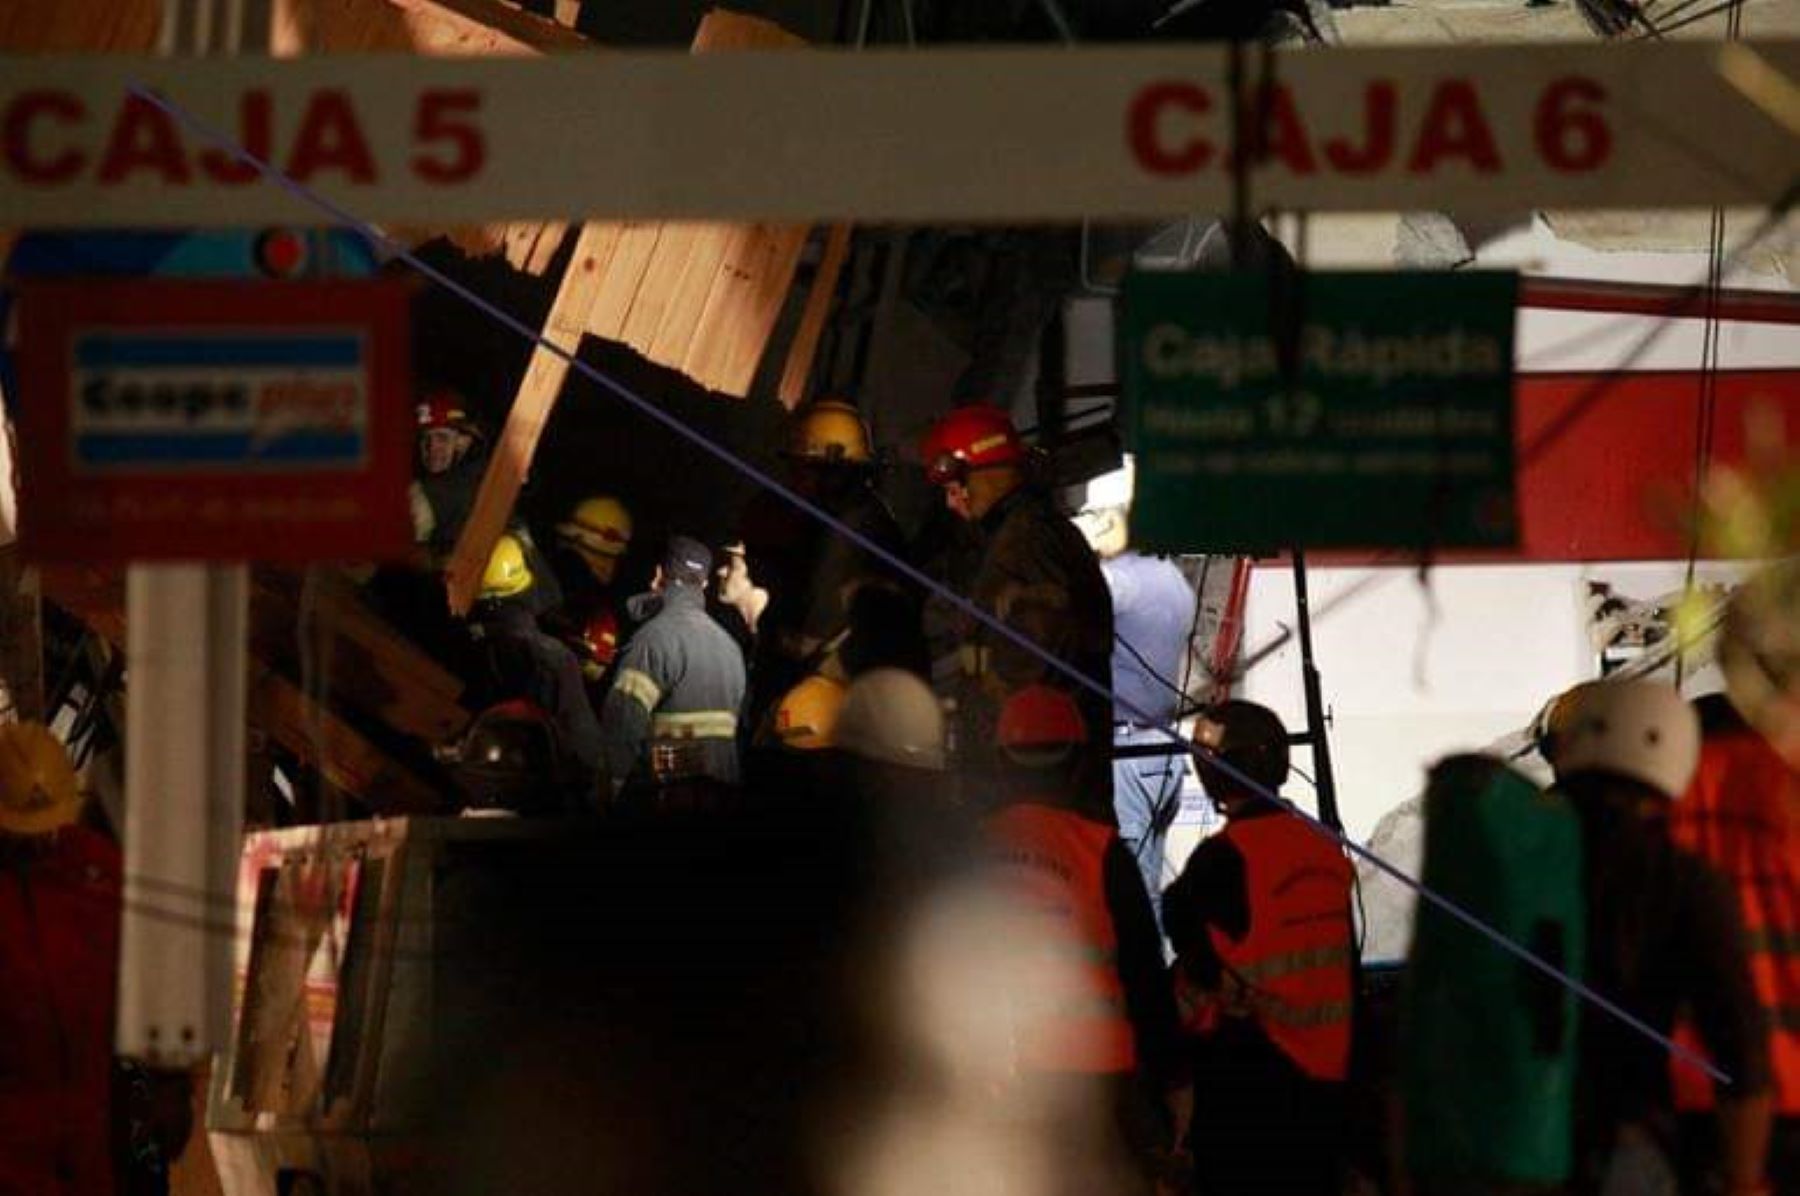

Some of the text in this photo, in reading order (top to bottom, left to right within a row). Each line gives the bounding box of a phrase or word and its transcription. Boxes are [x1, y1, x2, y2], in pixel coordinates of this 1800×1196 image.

[3, 86, 486, 186] CAJA 5
[1127, 75, 1614, 177] CAJA 6
[1141, 322, 1278, 389] Caja
